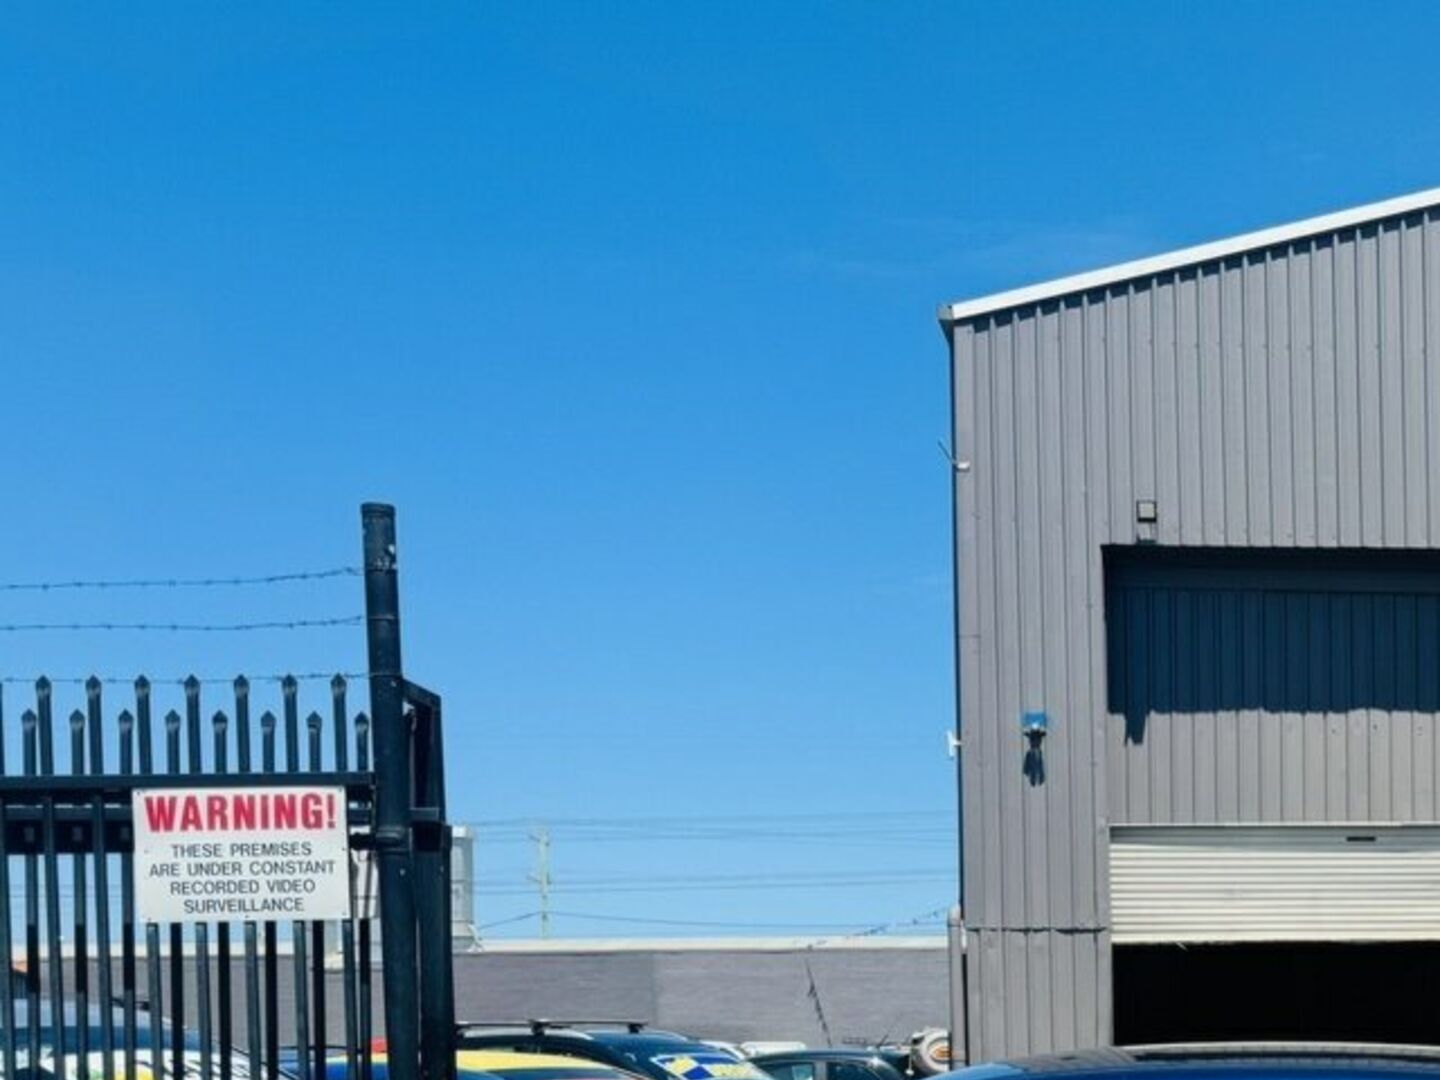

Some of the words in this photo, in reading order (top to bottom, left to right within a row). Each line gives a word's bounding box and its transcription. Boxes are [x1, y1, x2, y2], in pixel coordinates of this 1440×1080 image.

[144, 793, 336, 832] WARNING!
[171, 843, 223, 858] THESE
[229, 841, 313, 857] PREMISES
[149, 862, 181, 877] ARE
[187, 861, 243, 877] UNDER
[249, 860, 336, 876] CONSTANT
[170, 879, 260, 896] RECORDED
[266, 878, 317, 894] VIDEO
[183, 897, 305, 914] SURVEILLANCE
